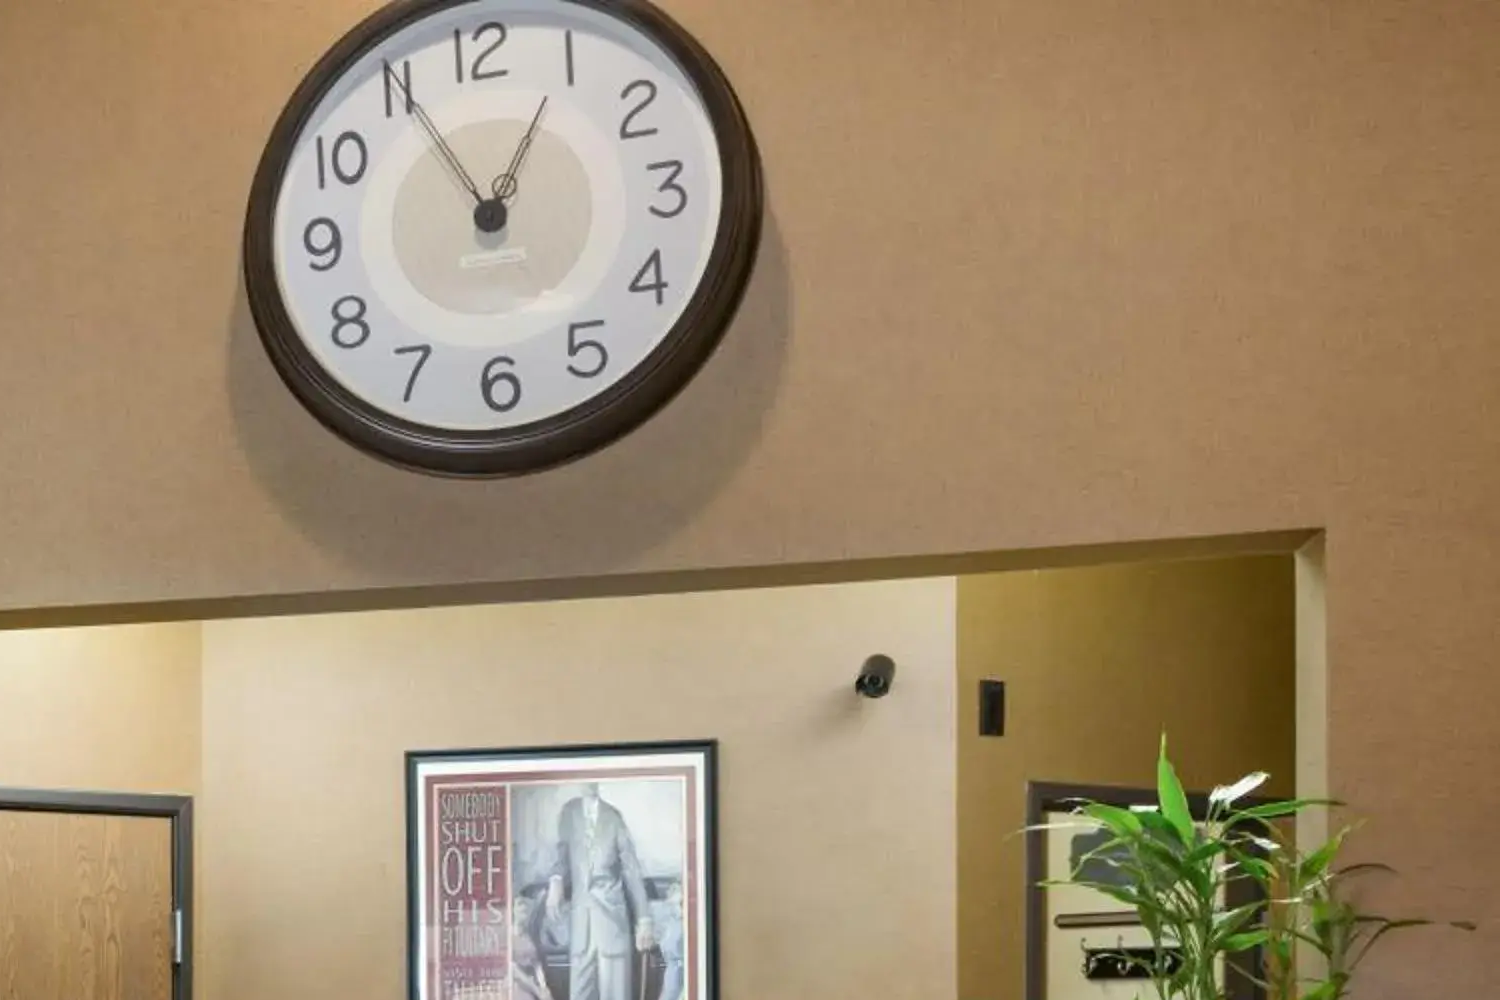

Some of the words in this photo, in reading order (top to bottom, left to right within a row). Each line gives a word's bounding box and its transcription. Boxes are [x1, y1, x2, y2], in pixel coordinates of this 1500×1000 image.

[454, 21, 509, 83] 12
[565, 29, 575, 86] 1
[619, 79, 659, 140] 2
[316, 131, 368, 190] 10
[646, 160, 687, 218] 3
[303, 217, 343, 271] 9
[628, 248, 668, 306] 4
[330, 295, 371, 349] 8
[566, 319, 608, 379] 5
[394, 344, 432, 402] 7
[480, 356, 521, 412] 6
[441, 820, 501, 844] SHUT
[441, 845, 502, 896] OFF
[443, 898, 504, 924] HIS
